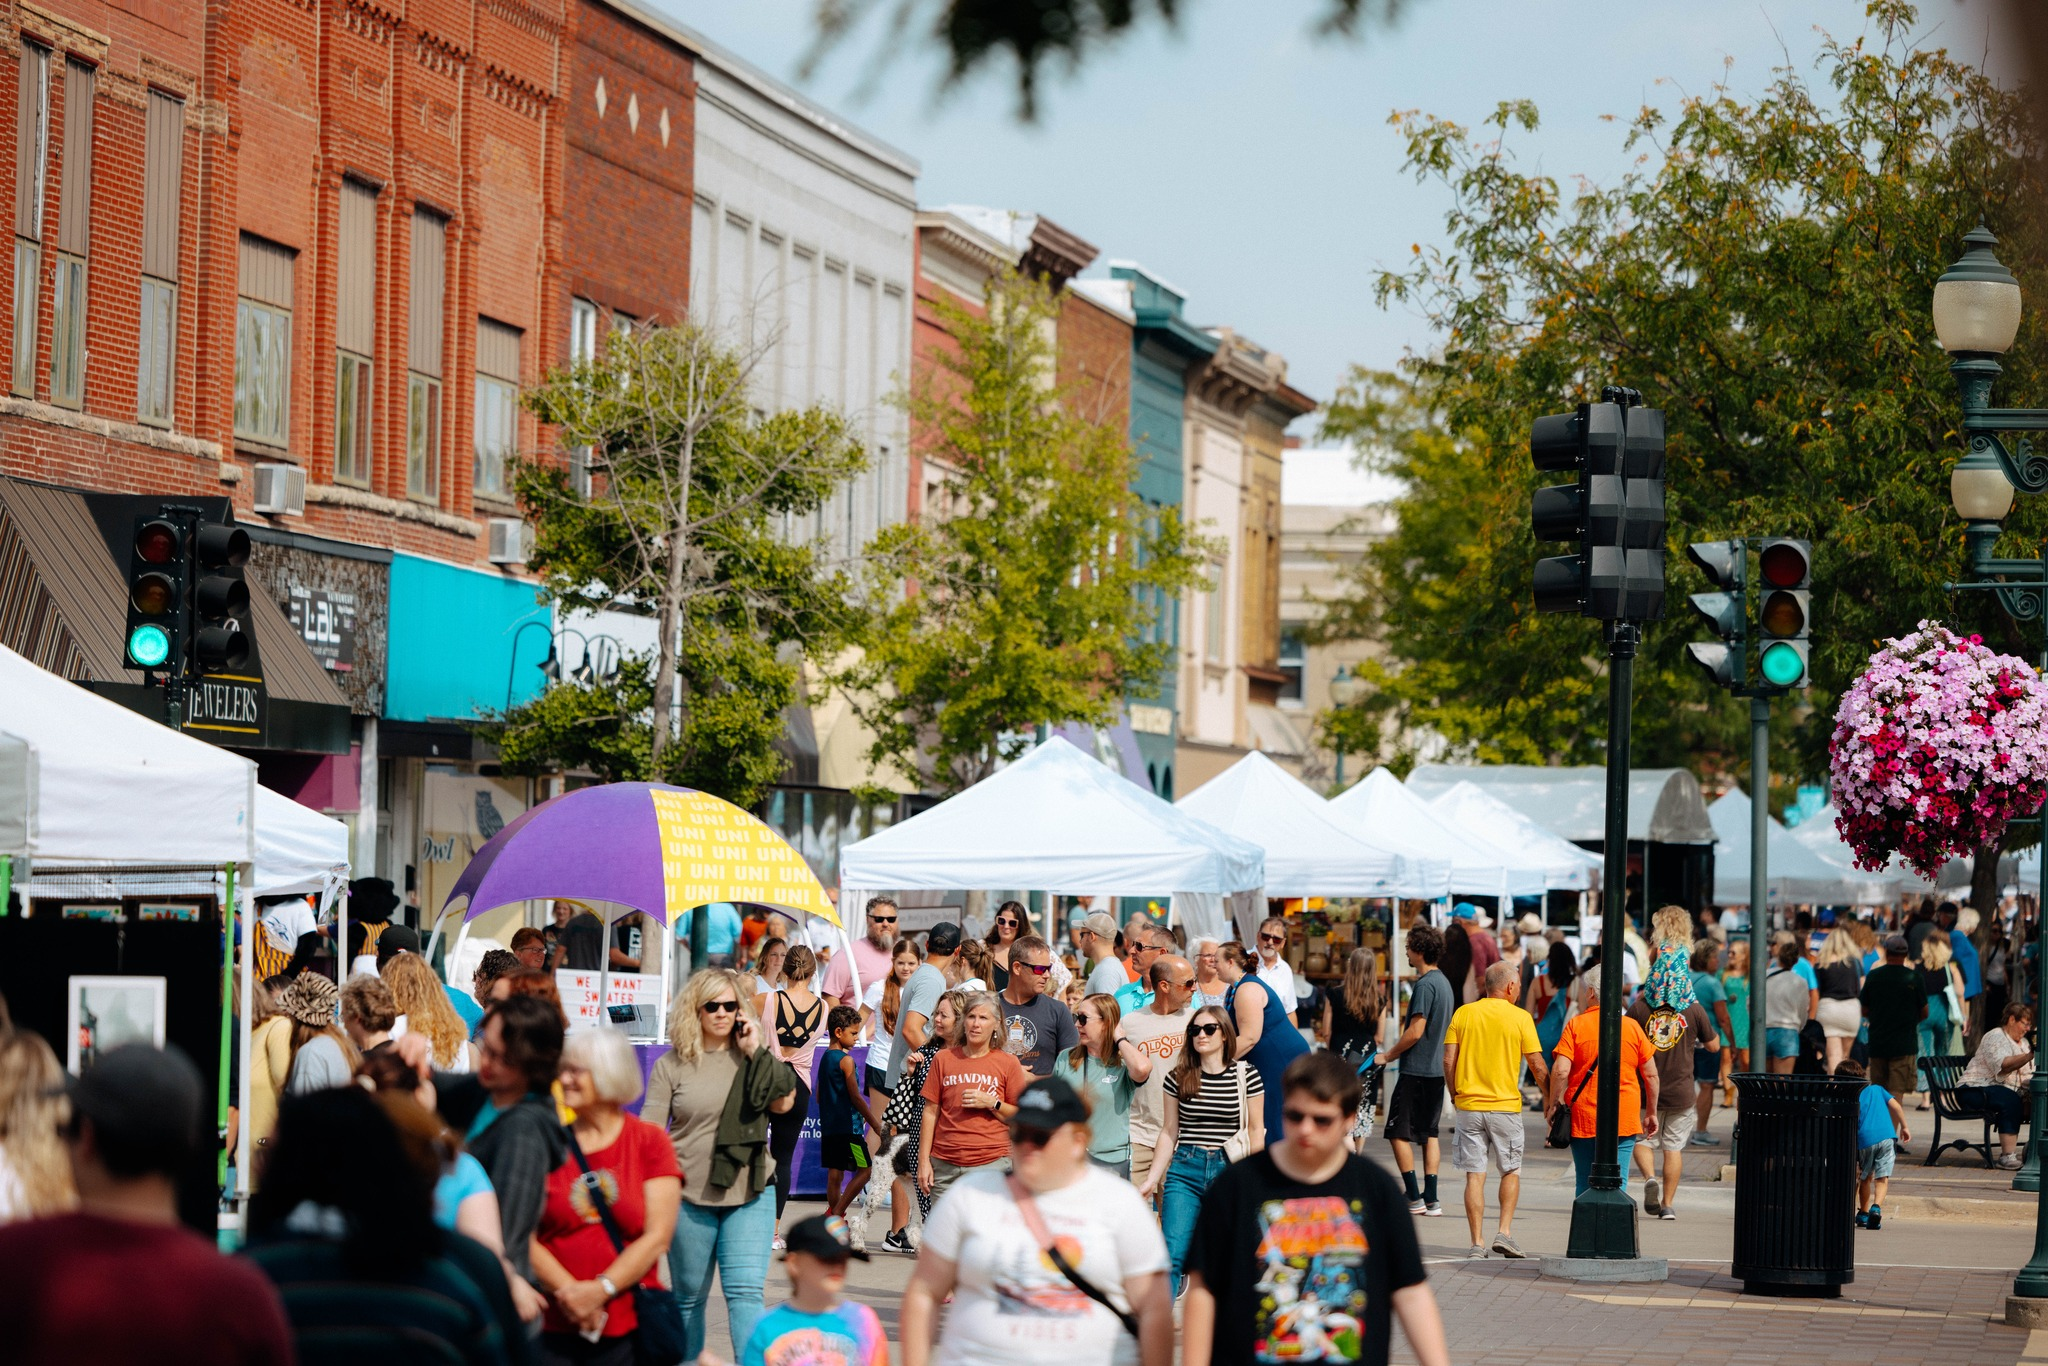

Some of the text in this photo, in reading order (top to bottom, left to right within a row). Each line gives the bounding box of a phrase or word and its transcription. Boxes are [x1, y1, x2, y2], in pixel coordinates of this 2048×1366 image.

[186, 683, 257, 727] JEWELERS
[690, 802, 725, 812] UNI
[661, 809, 763, 827] NI UNI UN
[671, 826, 706, 841] UNI
[715, 829, 750, 843] UNI
[669, 842, 792, 862] UNI UNI UNI
[664, 862, 681, 878] NI
[690, 863, 725, 880] UNI
[735, 866, 770, 882] UNI
[685, 884, 719, 901] UNI
[729, 886, 764, 902] UNI
[774, 888, 810, 905] UNI
[576, 976, 642, 990] WE WANT
[585, 991, 634, 1005] SWATER
[1160, 1036, 1183, 1059] SOU
[942, 1073, 999, 1087] GRANDMA
